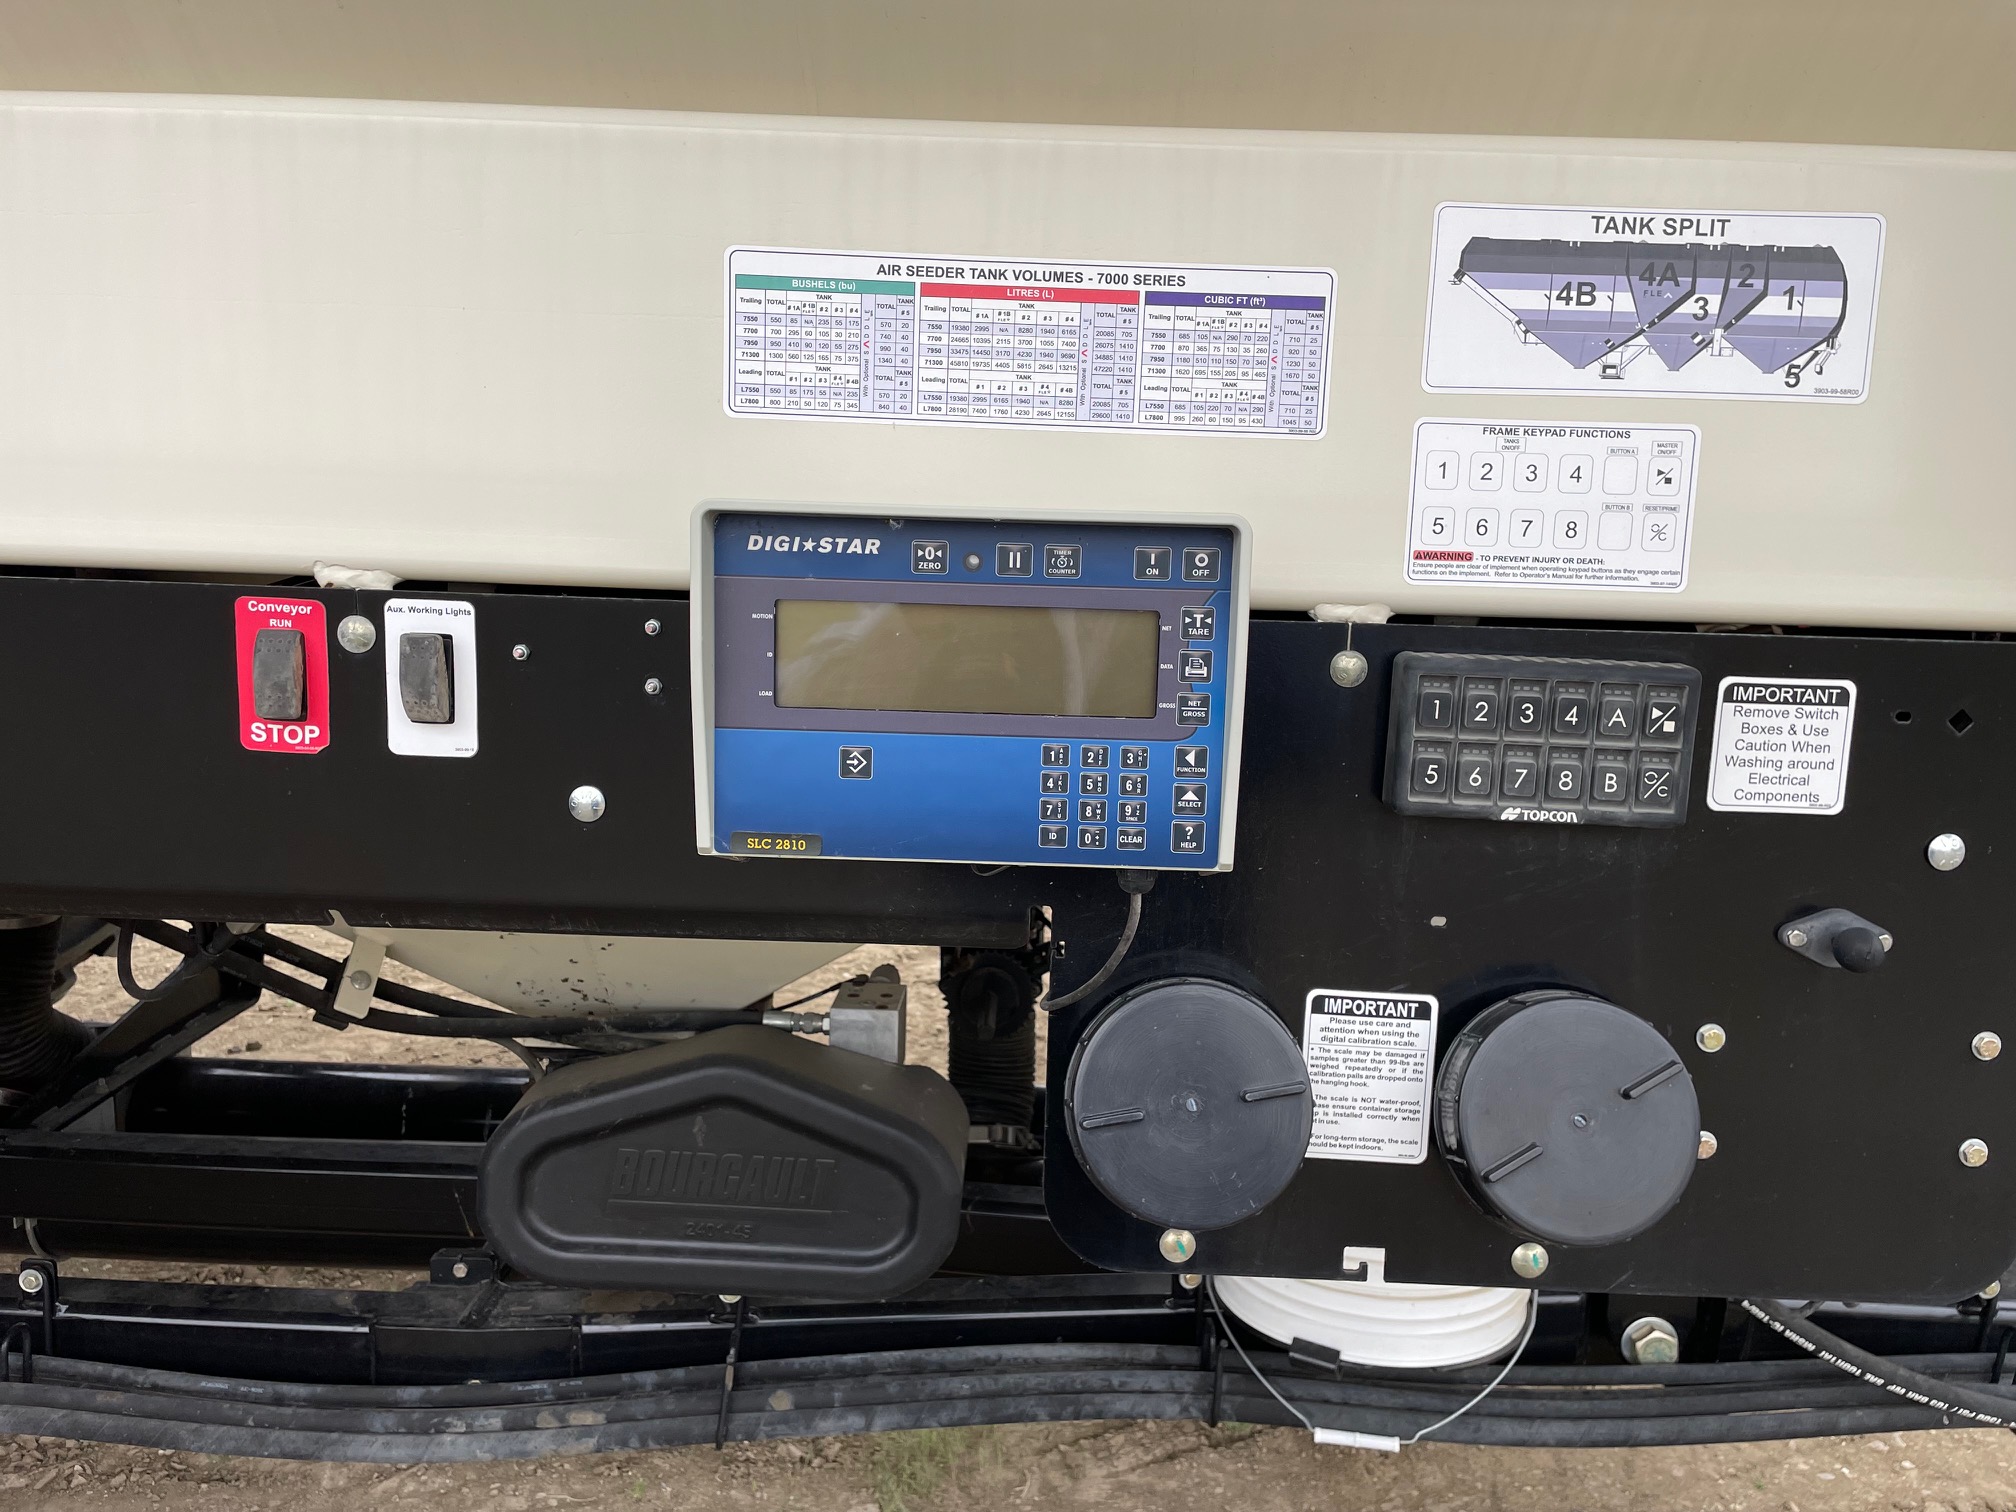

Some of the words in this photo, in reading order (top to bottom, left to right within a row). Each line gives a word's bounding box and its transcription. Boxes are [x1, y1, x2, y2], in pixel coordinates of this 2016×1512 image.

[1591, 215, 1655, 235] TANK
[1663, 218, 1731, 237] SPLIT
[877, 264, 901, 276] AIR
[906, 265, 965, 279] SEEDER
[969, 268, 1008, 280] TANK
[1012, 269, 1083, 283] VOLUMES
[1097, 273, 1128, 285] 7000
[1133, 274, 1186, 287] SERIES
[1638, 261, 1681, 287] 4A
[1736, 263, 1757, 288] 2
[792, 279, 836, 289] BUSHELS
[838, 281, 856, 292] (bu)
[1556, 281, 1597, 306] 4B
[740, 297, 762, 305] Trailing
[1007, 289, 1037, 297] LITRES
[1042, 290, 1054, 299] (L)
[1205, 295, 1234, 304] CUBIC
[1782, 285, 1795, 310] 1
[1692, 296, 1709, 321] 3
[1784, 364, 1802, 388] 5
[1483, 427, 1520, 436] FRAME
[1523, 428, 1566, 437] KEYPAD
[1569, 429, 1631, 439] FUNCTIONS
[1439, 462, 1446, 479] 1
[1480, 463, 1493, 480] 2
[1526, 464, 1537, 482] 3
[1570, 465, 1582, 483] 4
[1432, 517, 1444, 535] 5
[1476, 519, 1488, 536] 6
[1521, 520, 1533, 537] 7
[1565, 521, 1577, 538] 8
[1423, 552, 1472, 561] WARNING
[248, 600, 312, 616] Conveyor
[387, 605, 405, 613] Aux.
[408, 606, 443, 616] Working
[445, 608, 471, 617] Lights
[270, 619, 291, 627] RUN
[1733, 686, 1841, 704] IMPORTANT
[1434, 700, 1439, 719] 1
[1474, 702, 1488, 721] 2
[1520, 703, 1533, 723] 3
[1565, 706, 1578, 725] 4
[1608, 708, 1626, 727] A
[1733, 705, 1790, 719] Remove
[1794, 707, 1839, 720] Switch
[251, 722, 320, 744] STOP
[1741, 722, 1783, 735] Boxes
[1788, 724, 1797, 735] &
[1803, 724, 1829, 737] Use
[1735, 739, 1786, 752] Caution
[1792, 741, 1830, 753] When
[1050, 751, 1054, 761] 1
[1088, 752, 1094, 763] 2
[1127, 753, 1133, 764] 3
[1725, 755, 1783, 771] Washing
[1787, 759, 1835, 770] around
[1425, 765, 1438, 784] 5
[1469, 767, 1481, 786] 6
[1515, 769, 1528, 788] 7
[1559, 771, 1572, 790] 8
[1605, 773, 1617, 792] B
[1748, 773, 1810, 786] Electrical
[1047, 778, 1054, 788] 4
[1087, 779, 1093, 790] 5
[1126, 780, 1132, 791] 6
[1734, 788, 1819, 804] Components
[1046, 805, 1053, 815] 7
[1086, 806, 1092, 817] 8
[1125, 805, 1131, 816] 9
[1522, 810, 1577, 823] TOPCON
[747, 838, 771, 849] SLC
[776, 839, 806, 850] 2810
[1085, 833, 1091, 844] 0
[1120, 835, 1142, 843] CLEAR
[1324, 998, 1419, 1018] IMPORTANT
[1330, 1017, 1356, 1025] Please
[1319, 1026, 1355, 1034] attention
[1381, 1030, 1405, 1038] using
[1321, 1035, 1346, 1043] digital
[1348, 1037, 1391, 1045] calibration
[611, 1148, 835, 1205] BOURGAULT
